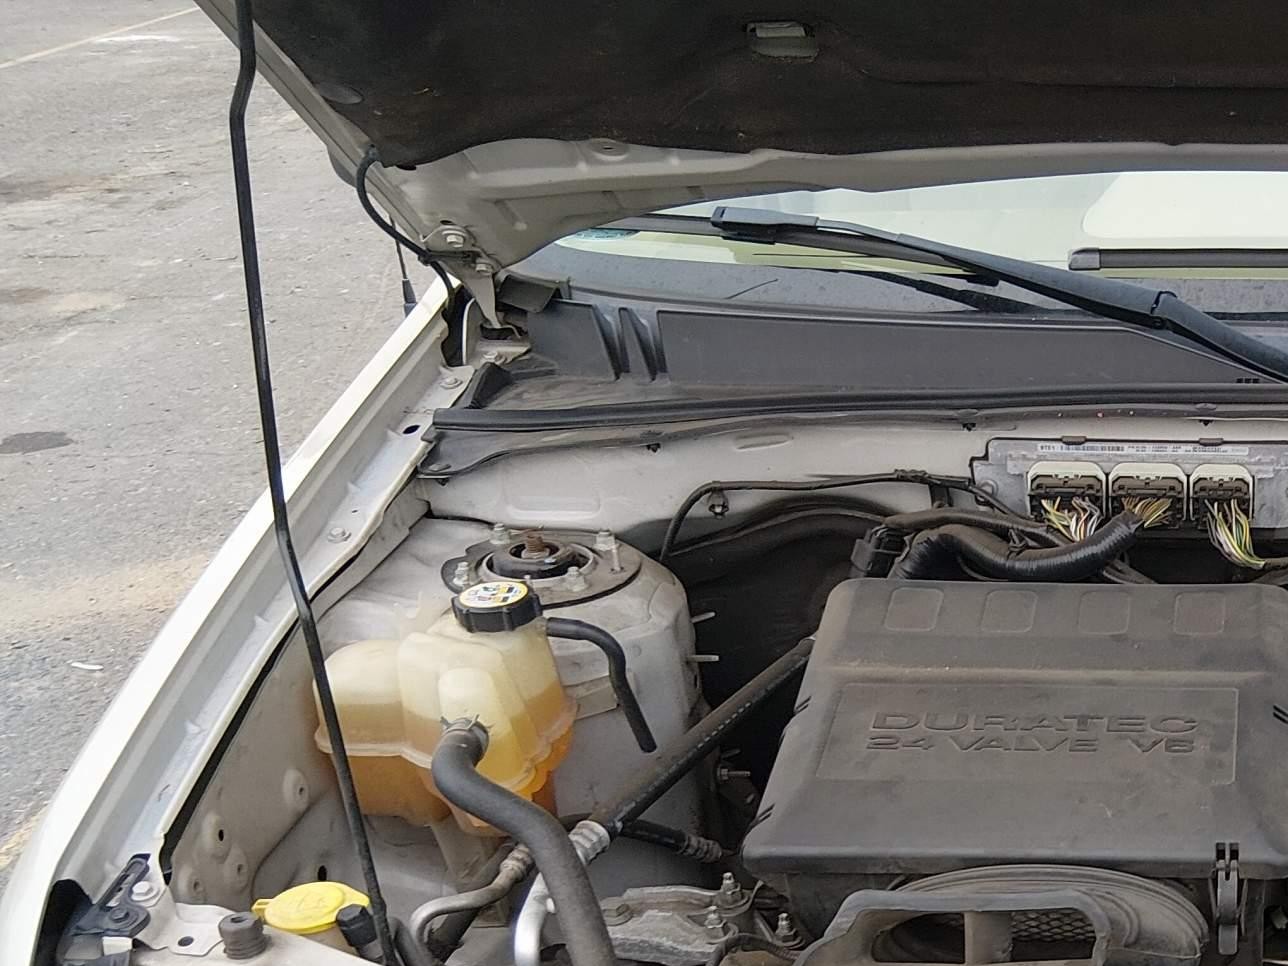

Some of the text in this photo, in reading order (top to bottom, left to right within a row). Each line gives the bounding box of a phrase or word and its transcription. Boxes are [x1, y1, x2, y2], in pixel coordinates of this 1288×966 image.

[871, 711, 1199, 734] DURATEC
[866, 735, 1195, 754] 24 VALVE V6
